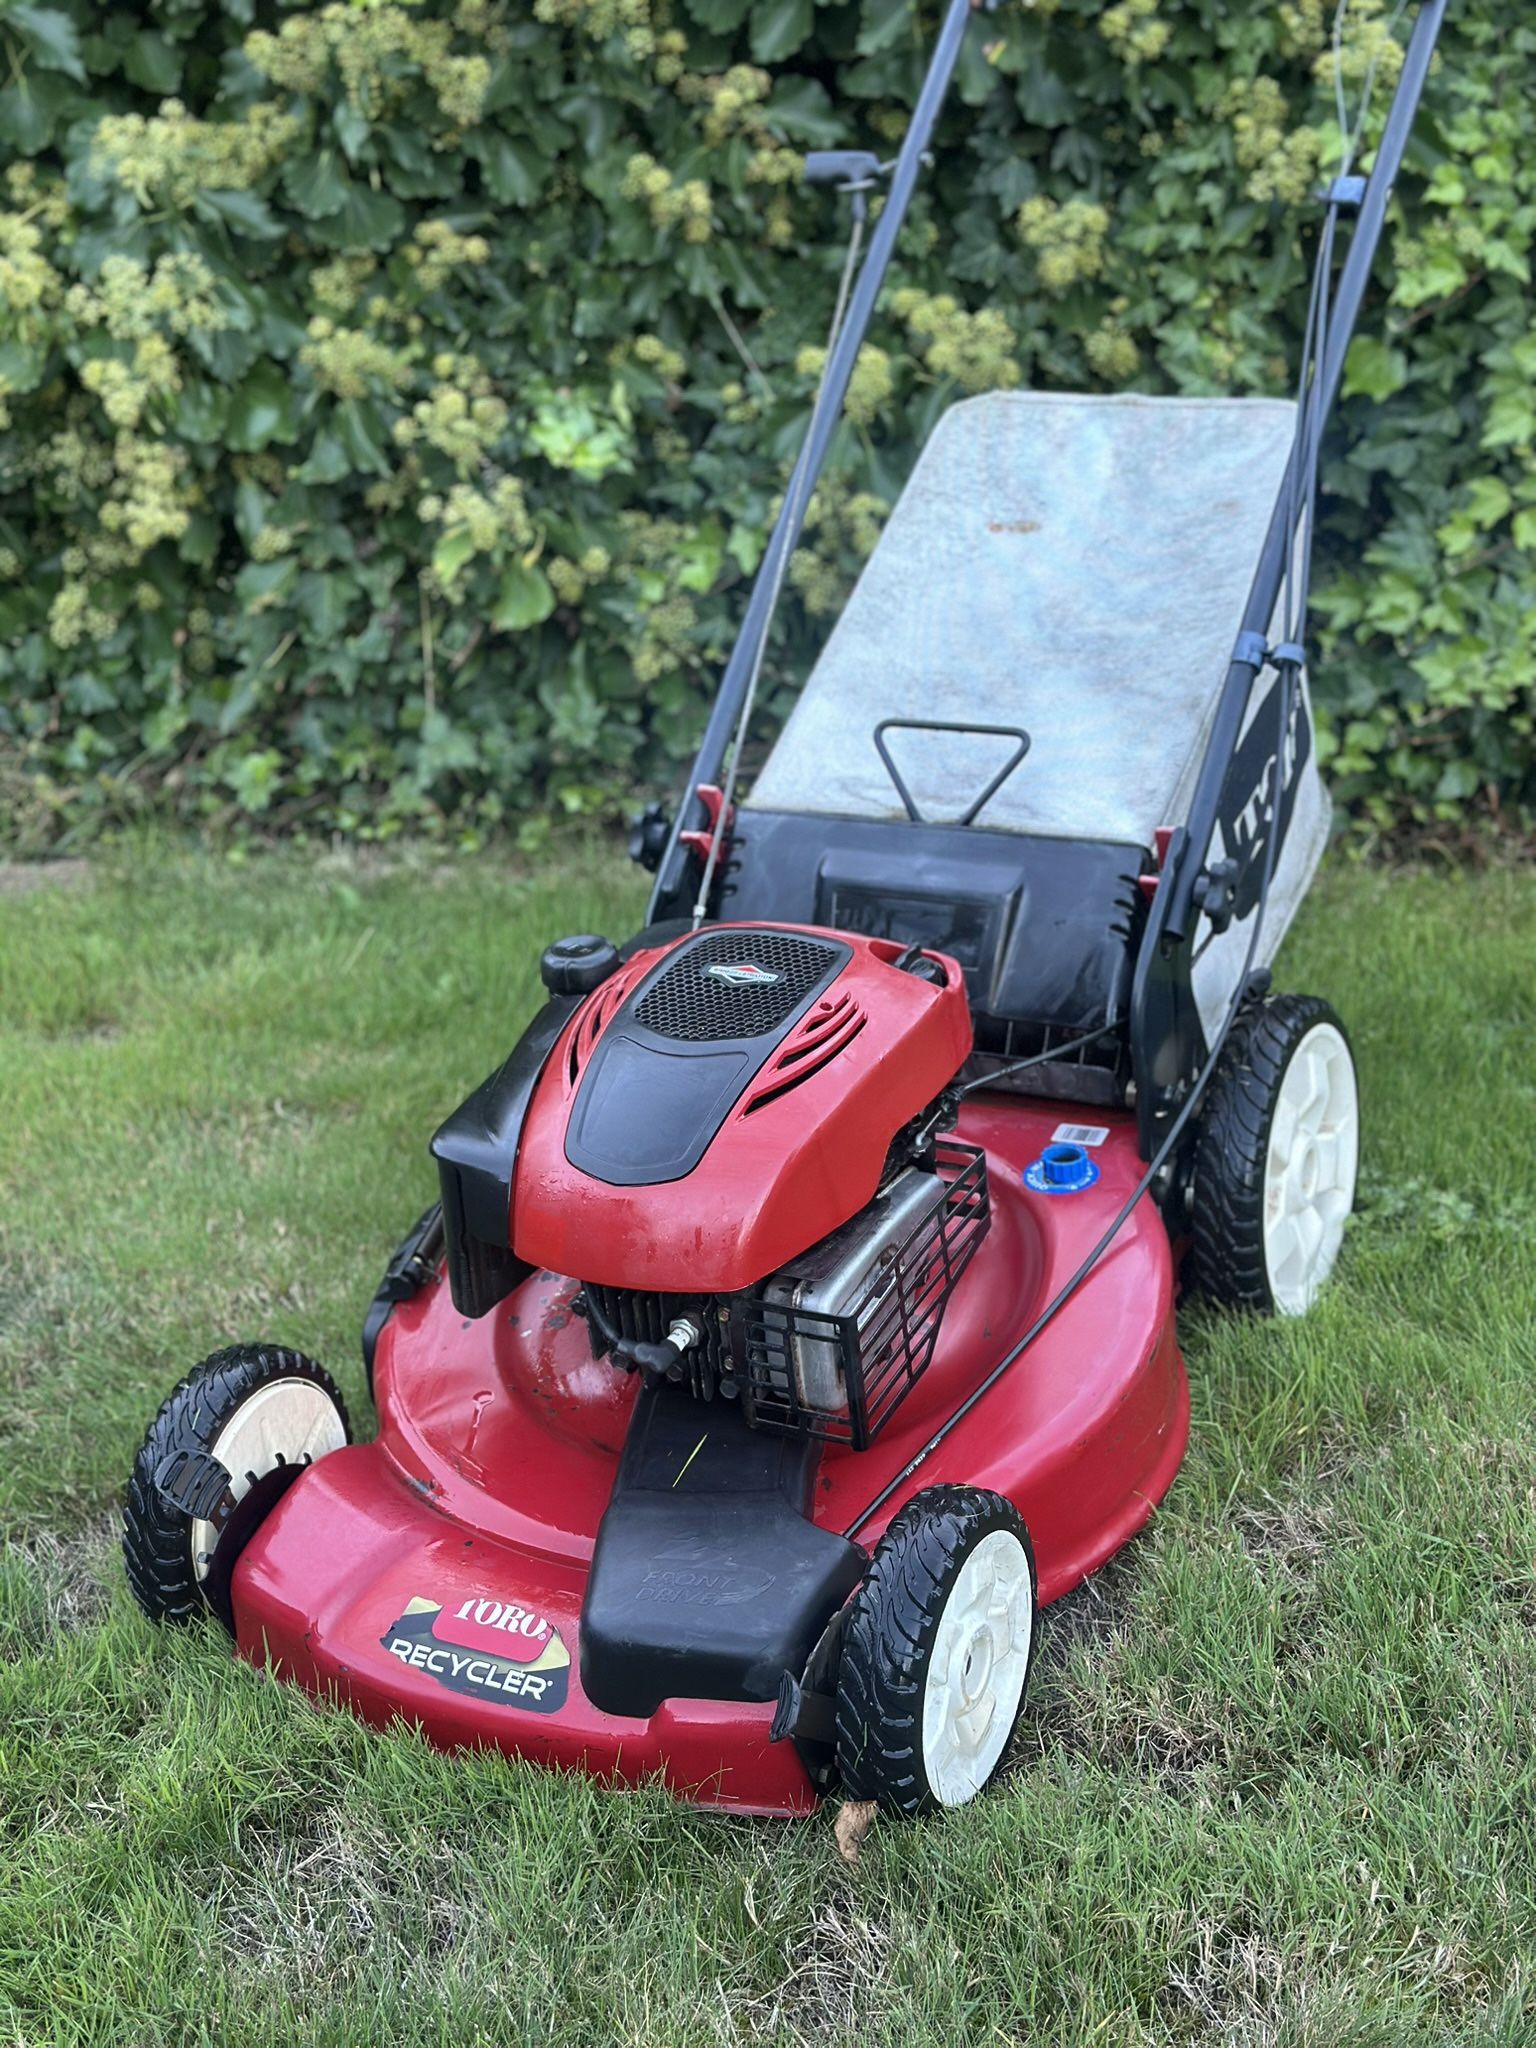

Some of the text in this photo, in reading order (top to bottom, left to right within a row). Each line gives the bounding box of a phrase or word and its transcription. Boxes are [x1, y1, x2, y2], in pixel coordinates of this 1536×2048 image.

[642, 1569, 736, 1589] FRONT
[635, 1586, 725, 1606] DRIVE
[389, 1638, 552, 1700] RECYCLER
